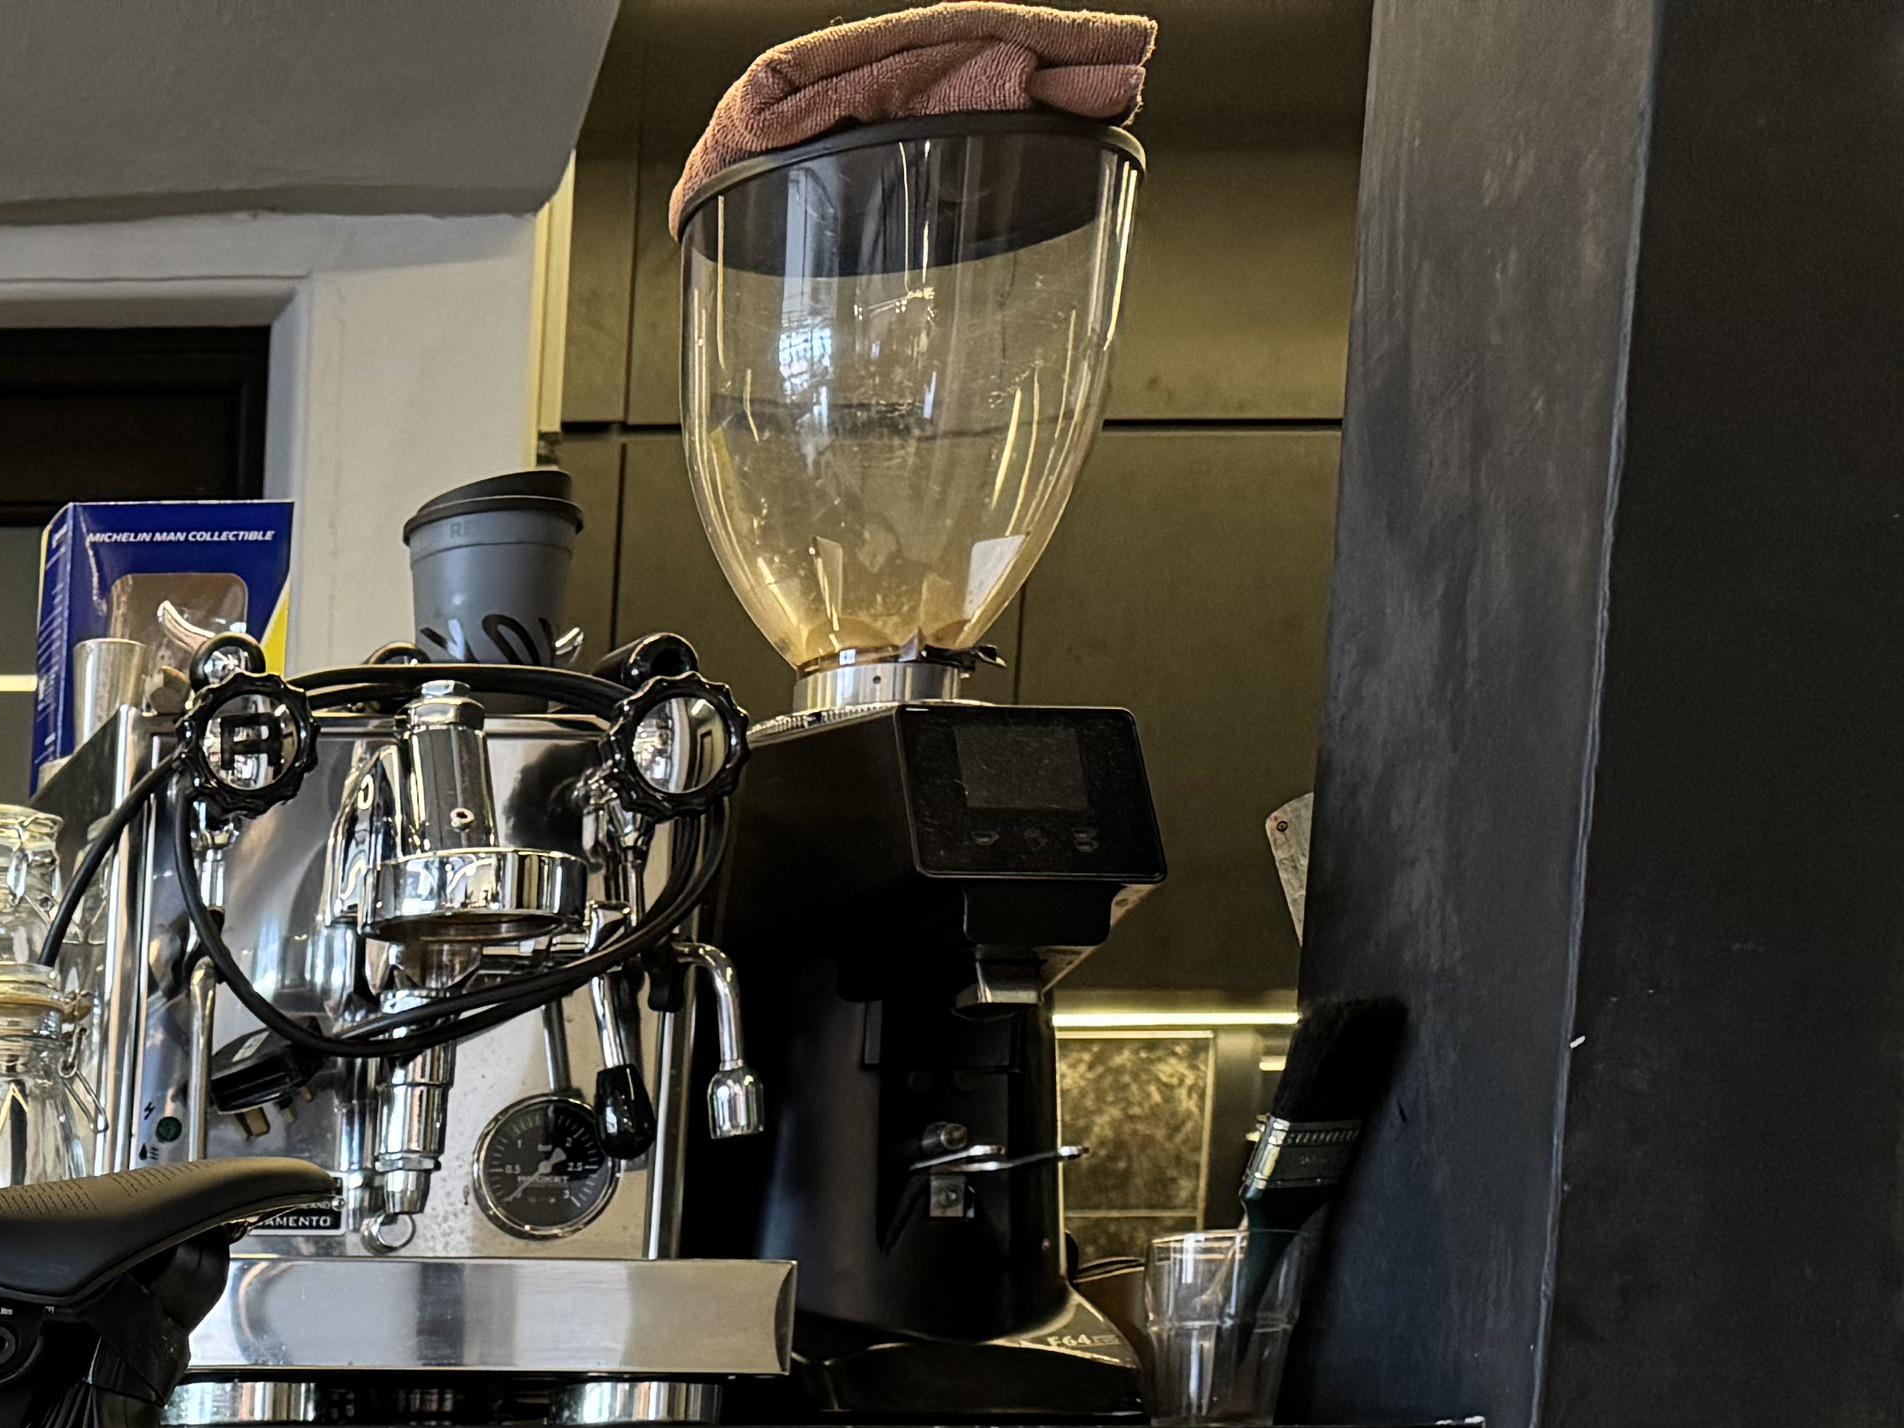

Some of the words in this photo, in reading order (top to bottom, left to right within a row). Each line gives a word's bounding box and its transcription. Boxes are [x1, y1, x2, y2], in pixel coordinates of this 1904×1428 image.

[86, 531, 153, 543] MICHELIN
[153, 531, 186, 542] MAN
[188, 530, 275, 542] COLLECTIBLE
[567, 1162, 583, 1171] 2.5
